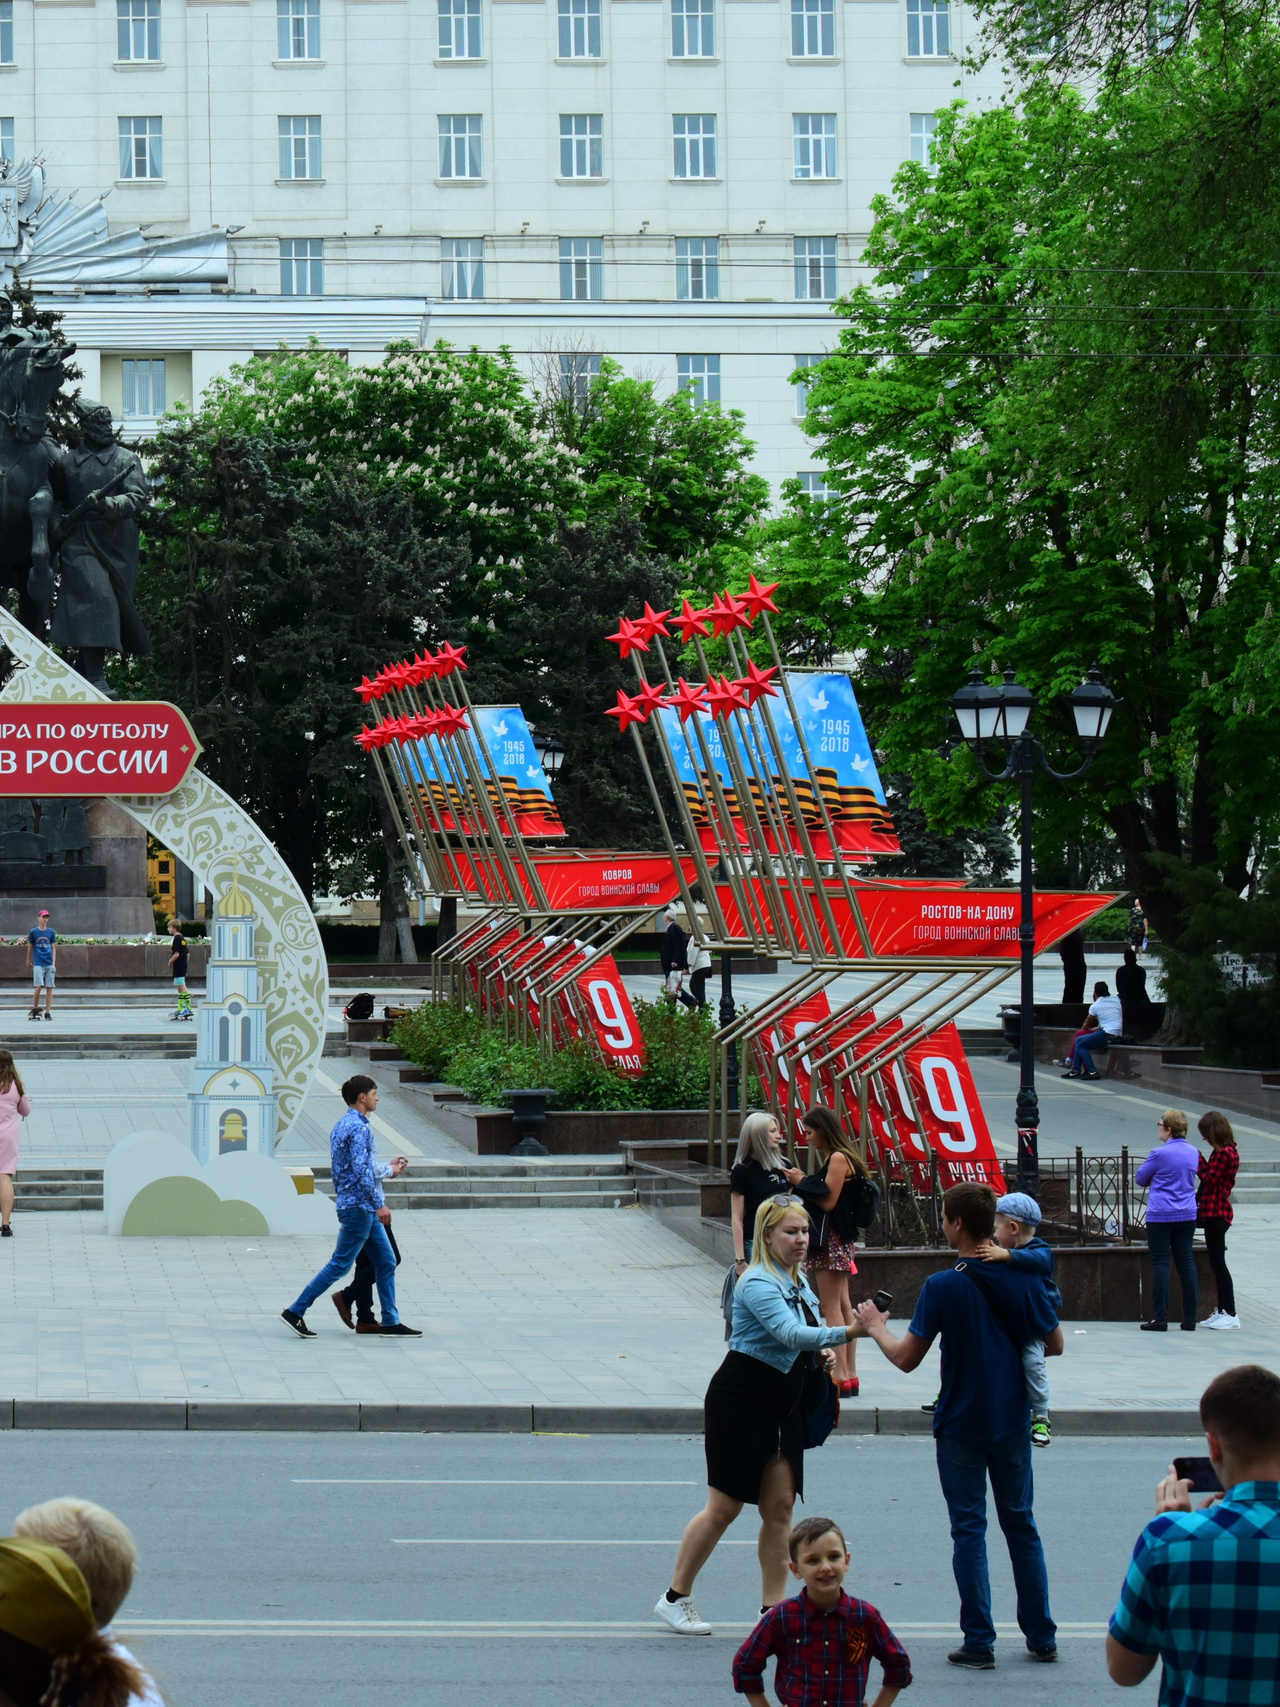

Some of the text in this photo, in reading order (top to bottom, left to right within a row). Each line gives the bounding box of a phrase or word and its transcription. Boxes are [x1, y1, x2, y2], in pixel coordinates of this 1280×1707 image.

[37, 723, 66, 739] ПО
[70, 723, 169, 739] ФУТБОЛУ
[821, 719, 850, 735] 1945
[503, 741, 525, 752] 1945
[821, 737, 849, 752] 2018
[26, 750, 168, 774] РОССИИ
[503, 753, 525, 765] 2018
[602, 869, 633, 880] КОВРОВ
[578, 883, 660, 897] ГОРОД ВОИНСКОЙ СЛАВЫ
[921, 905, 1015, 920] РОСТОВ-НА-ДОНУ
[913, 925, 942, 941] ГОРОД
[944, 925, 991, 940] ВОИНСКОЙ
[588, 980, 634, 1049] 9
[920, 1057, 978, 1153] 9
[947, 1162, 989, 1182] МАЯ
